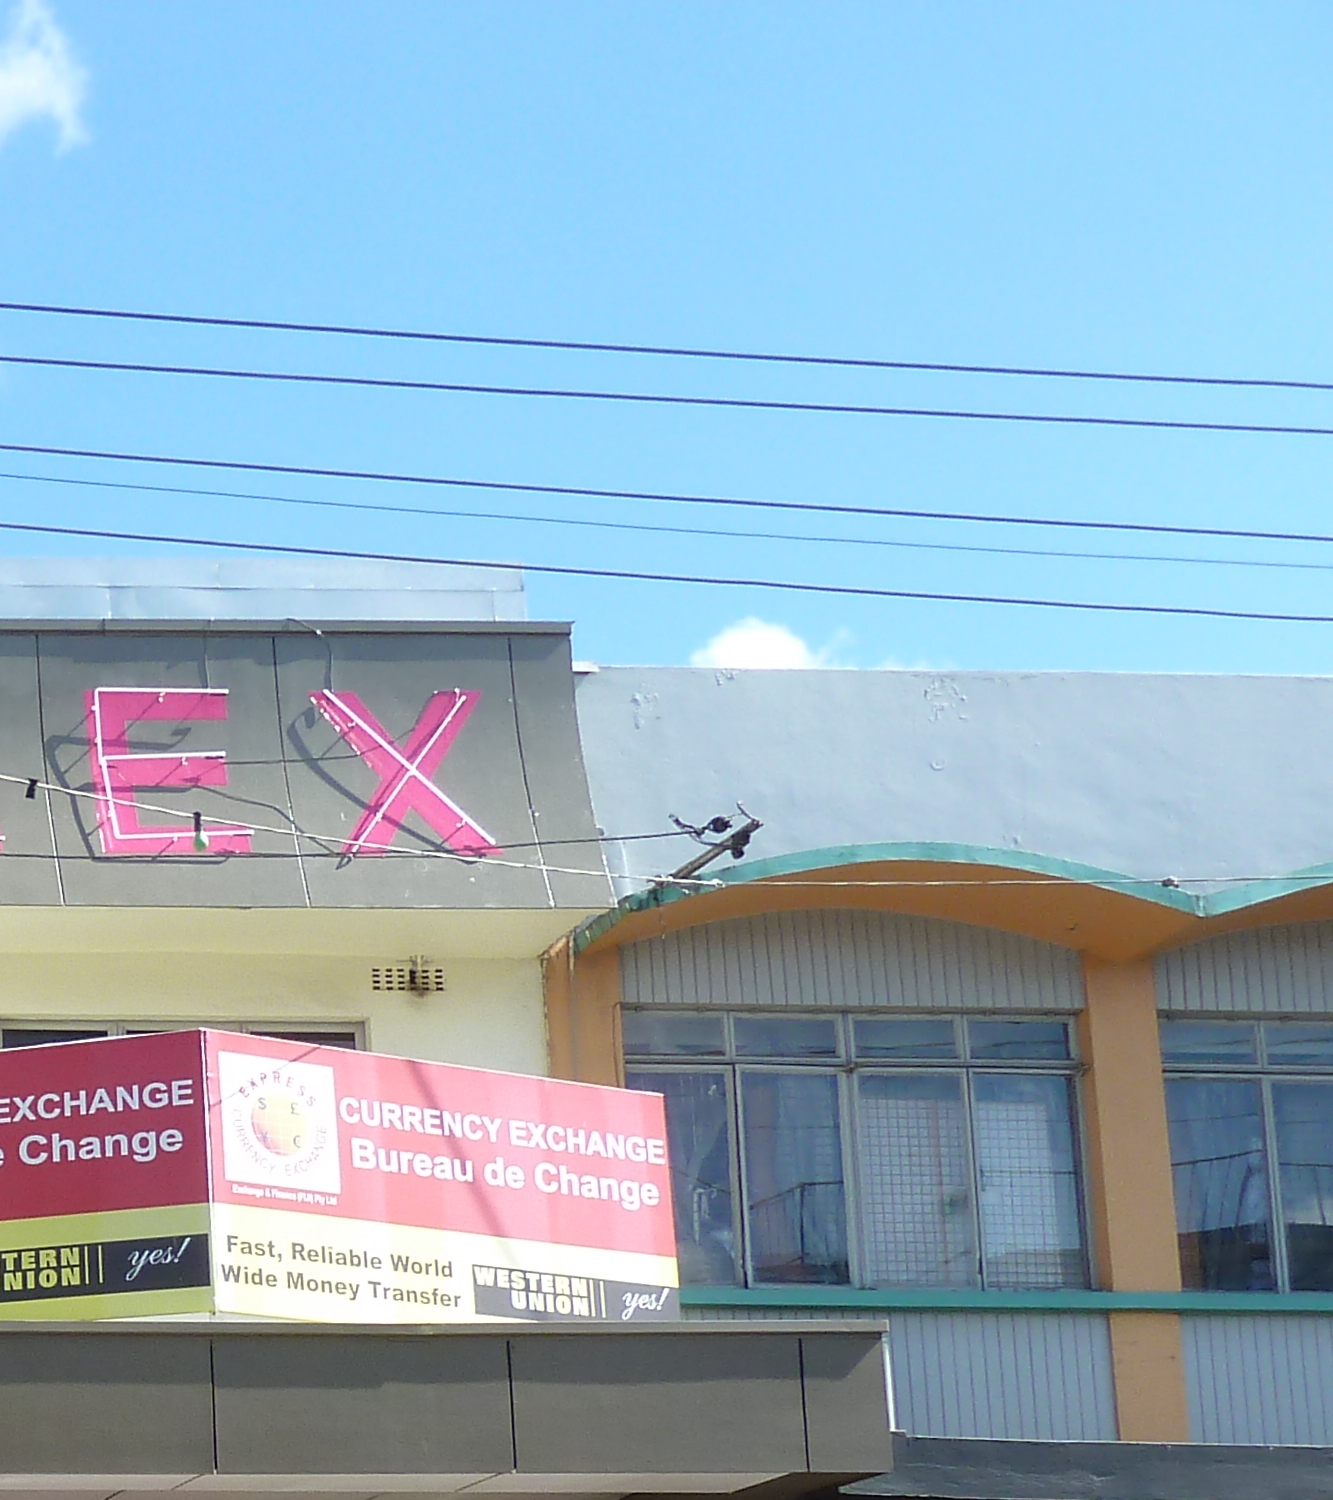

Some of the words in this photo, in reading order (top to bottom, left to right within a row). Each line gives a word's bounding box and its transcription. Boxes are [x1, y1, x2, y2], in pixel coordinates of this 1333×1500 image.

[238, 1071, 316, 1107] EXPRESS
[19, 1128, 184, 1166] Change
[339, 1097, 502, 1143] CURRENCY
[508, 1120, 666, 1165] EXCHANGE
[350, 1137, 474, 1182] Bureau
[484, 1156, 525, 1189] de
[534, 1162, 660, 1210] Change
[126, 1237, 191, 1281] yes!
[226, 1235, 282, 1262] Fast,
[291, 1242, 382, 1269] Reliable
[390, 1254, 453, 1278] World
[221, 1264, 278, 1287] Wide
[287, 1271, 360, 1301] Money
[368, 1280, 462, 1307] Transfer
[473, 1266, 589, 1297] WESTERN
[510, 1290, 590, 1317] UNION
[622, 1288, 669, 1320] yes!
